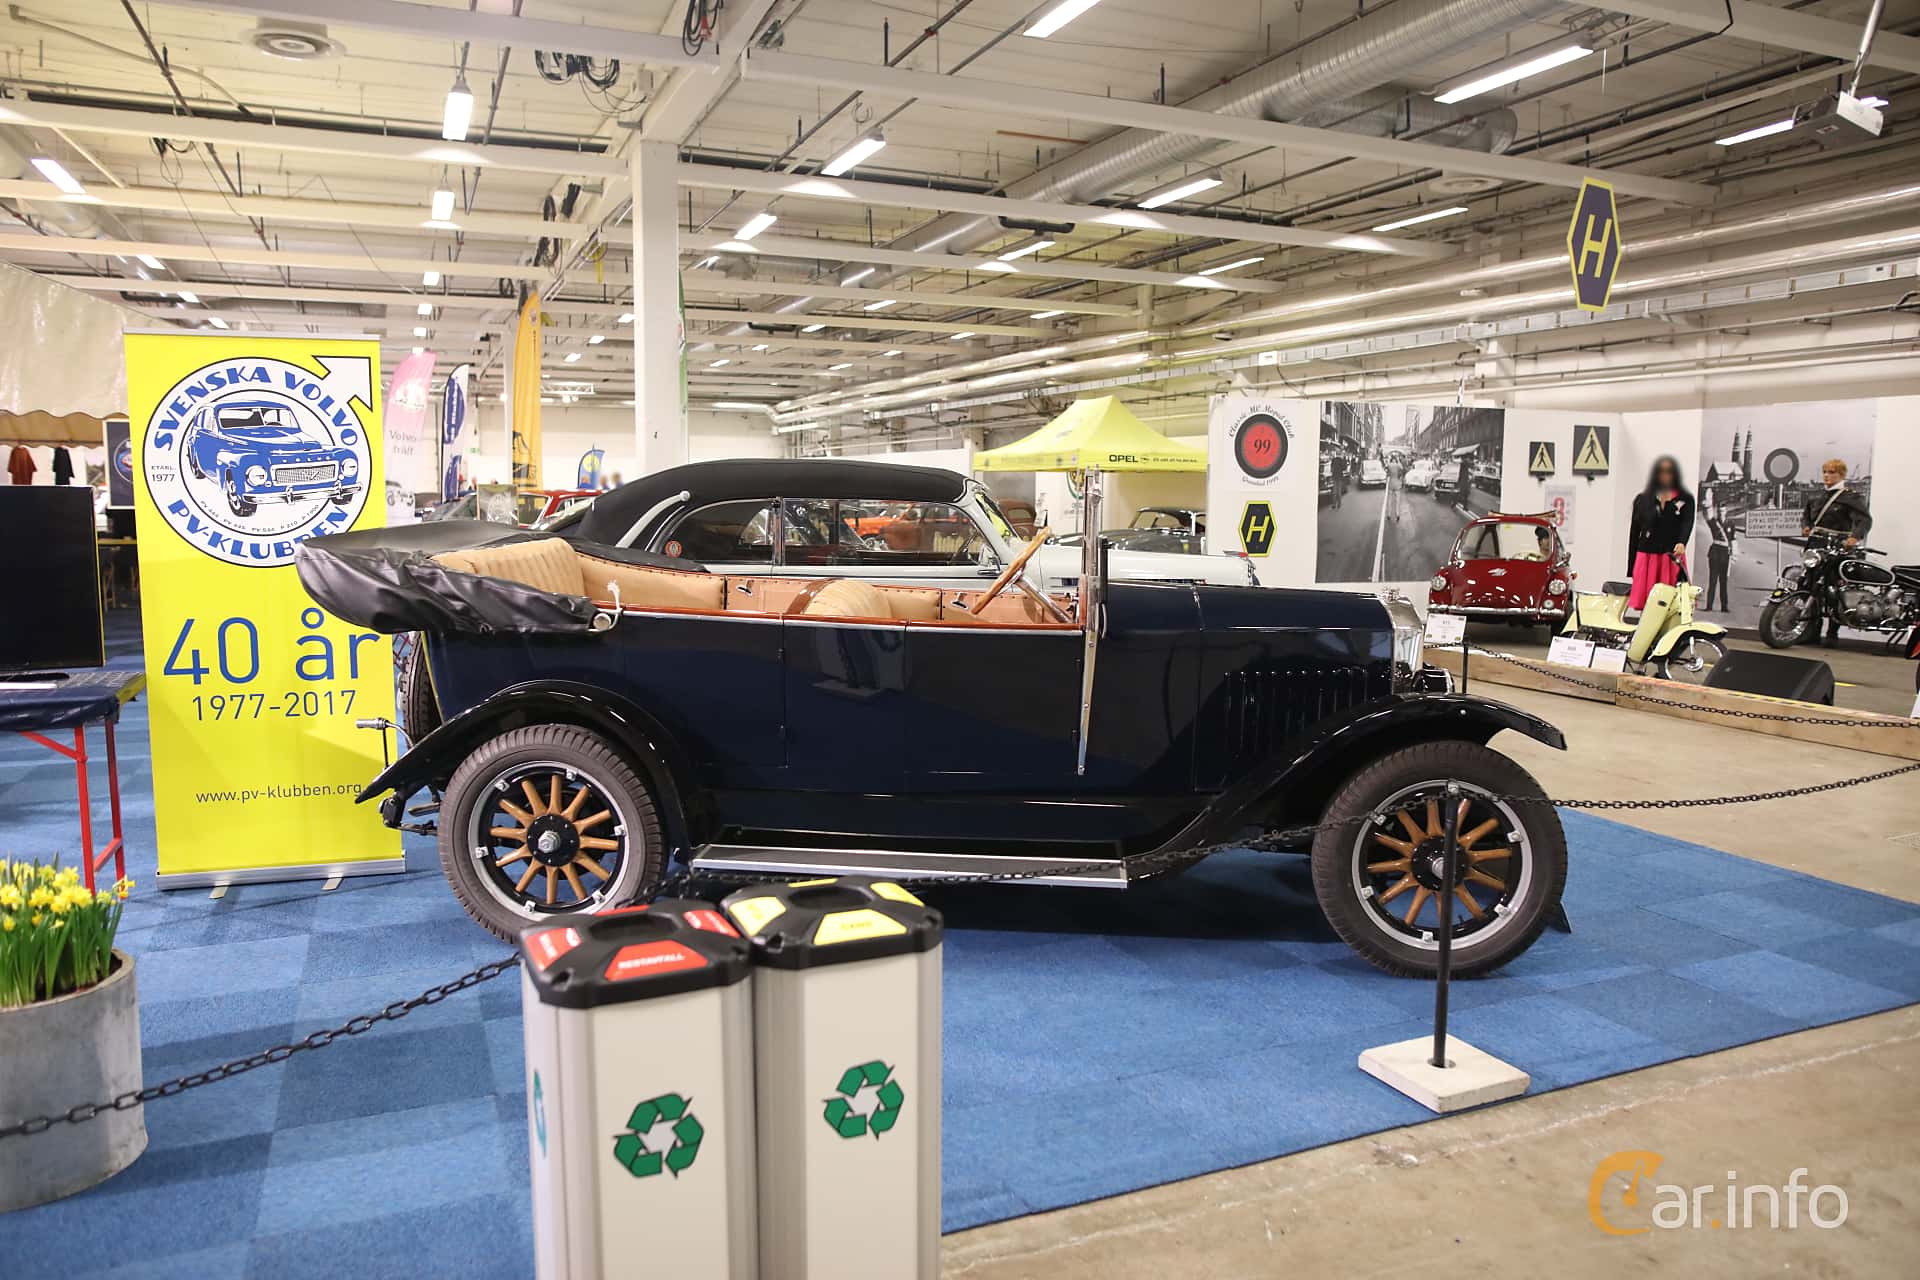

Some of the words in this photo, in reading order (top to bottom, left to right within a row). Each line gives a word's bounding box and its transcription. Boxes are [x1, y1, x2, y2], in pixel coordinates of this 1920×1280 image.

[1578, 214, 1612, 278] H
[154, 366, 272, 451] SVENSKA
[284, 370, 358, 446] VOLVO
[389, 430, 416, 441] Volvo
[1284, 419, 1295, 439] Club
[1254, 439, 1271, 455] 99
[1109, 454, 1138, 463] OPEL
[152, 473, 175, 482] 1977
[1246, 516, 1270, 542] H
[163, 617, 259, 685] 40
[295, 607, 380, 681] år
[192, 690, 356, 721] 1977-2017
[196, 783, 362, 803] www.pv-klubben.org
